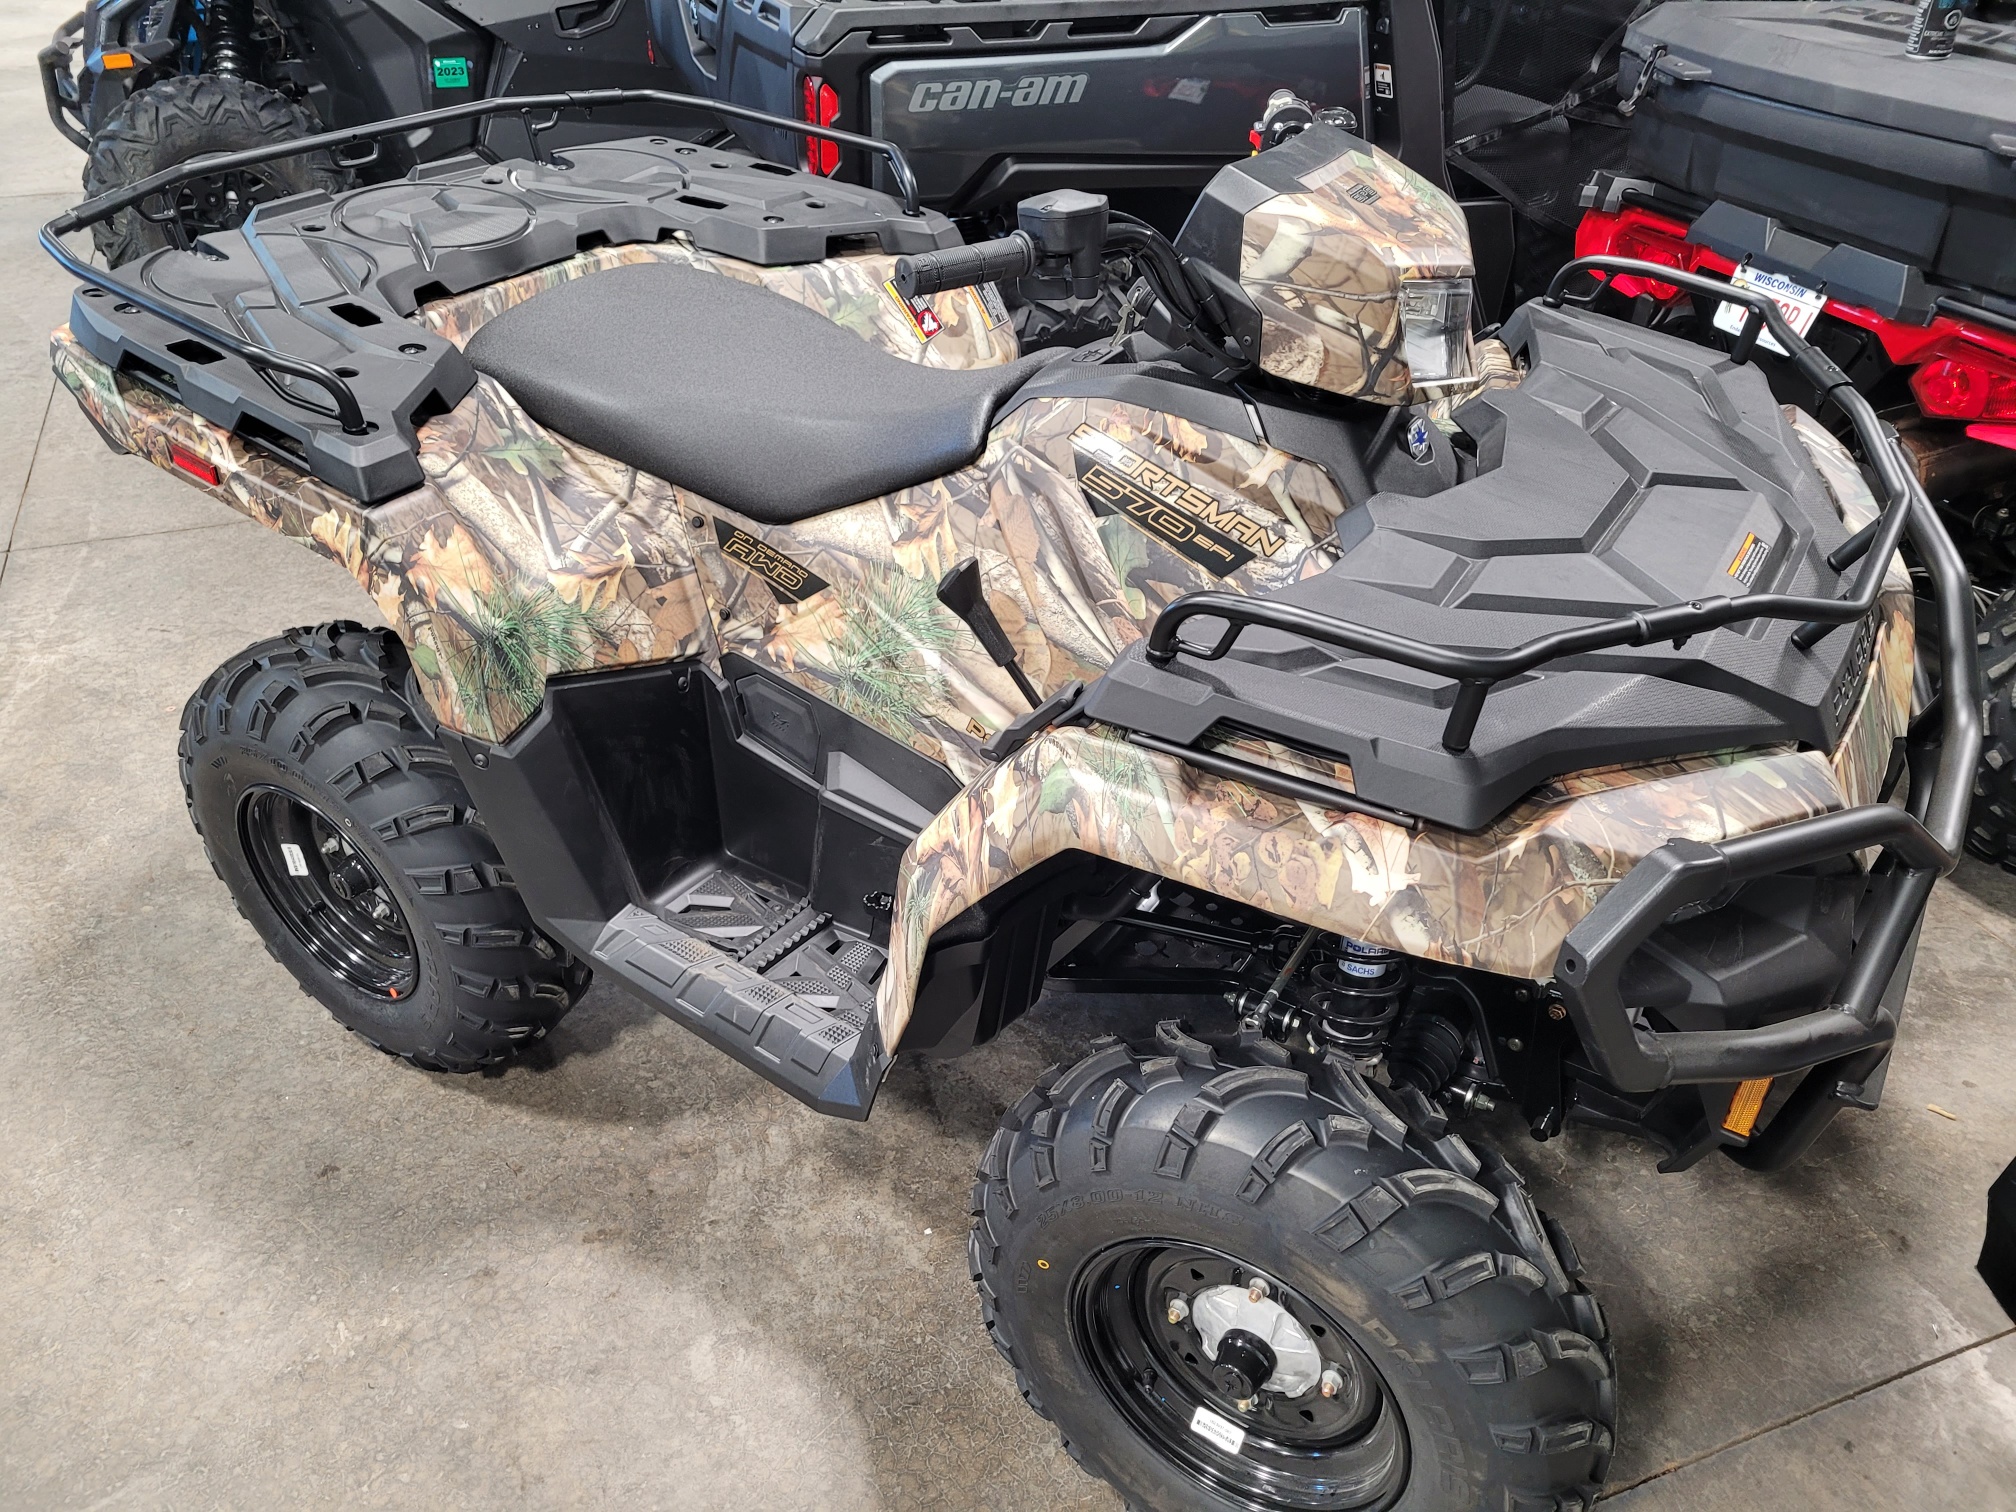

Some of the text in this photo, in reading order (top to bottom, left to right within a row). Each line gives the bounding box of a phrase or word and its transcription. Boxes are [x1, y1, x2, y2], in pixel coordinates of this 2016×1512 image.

[437, 67, 465, 77] 2023
[908, 74, 1088, 113] can-am
[1754, 272, 1808, 298] WISCONSIN
[1081, 464, 1236, 562] 570 EFI
[723, 537, 803, 590] AWD
[757, 543, 808, 578] DEMAND
[1347, 963, 1375, 976] SACHS
